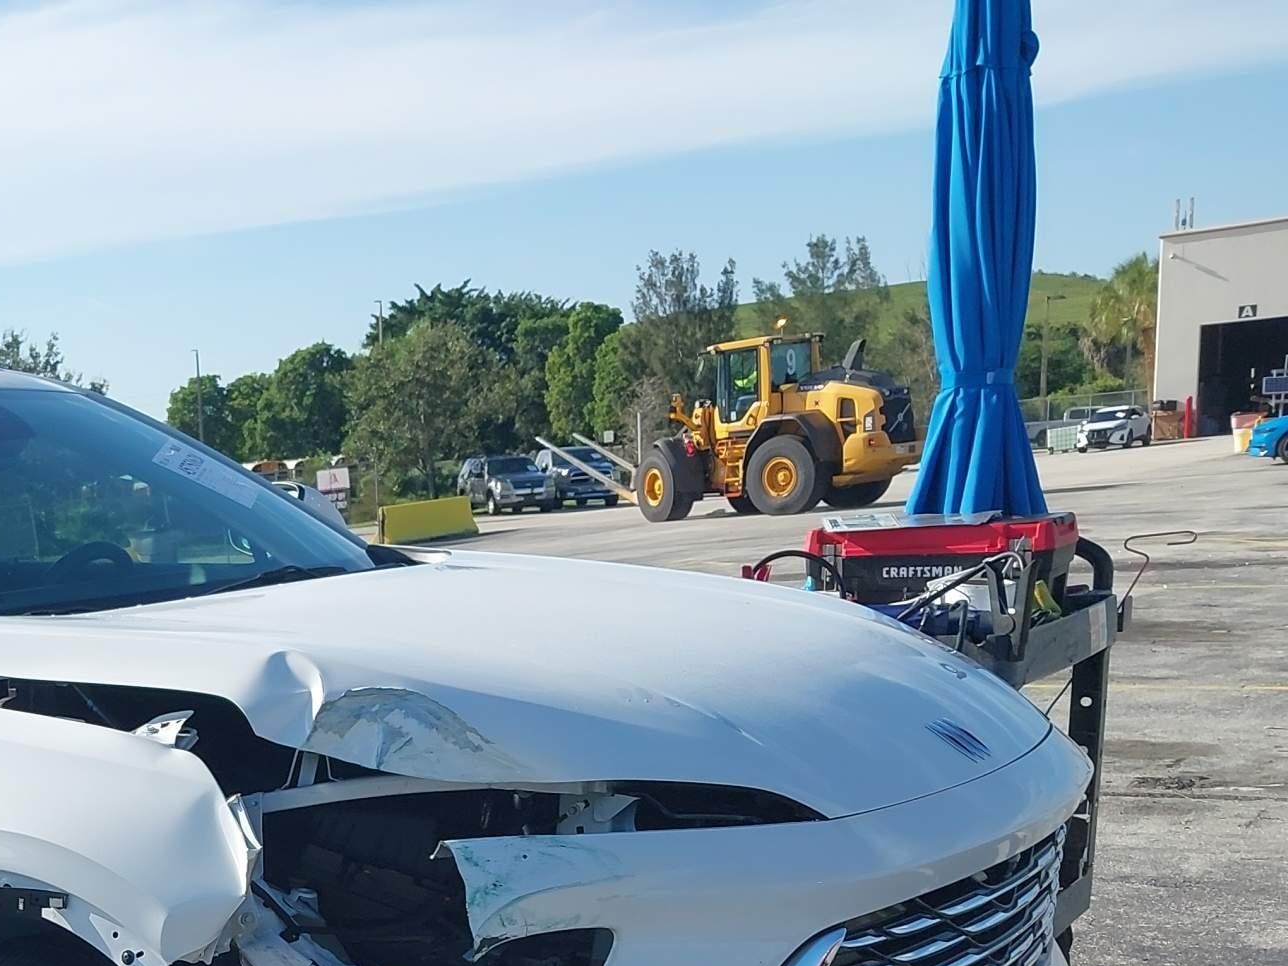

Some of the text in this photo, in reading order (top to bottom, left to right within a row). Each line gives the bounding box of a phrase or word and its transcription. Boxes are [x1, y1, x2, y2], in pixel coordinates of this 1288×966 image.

[1242, 306, 1252, 317] A
[786, 348, 797, 375] 9
[882, 565, 963, 579] CRAFTSMAN
